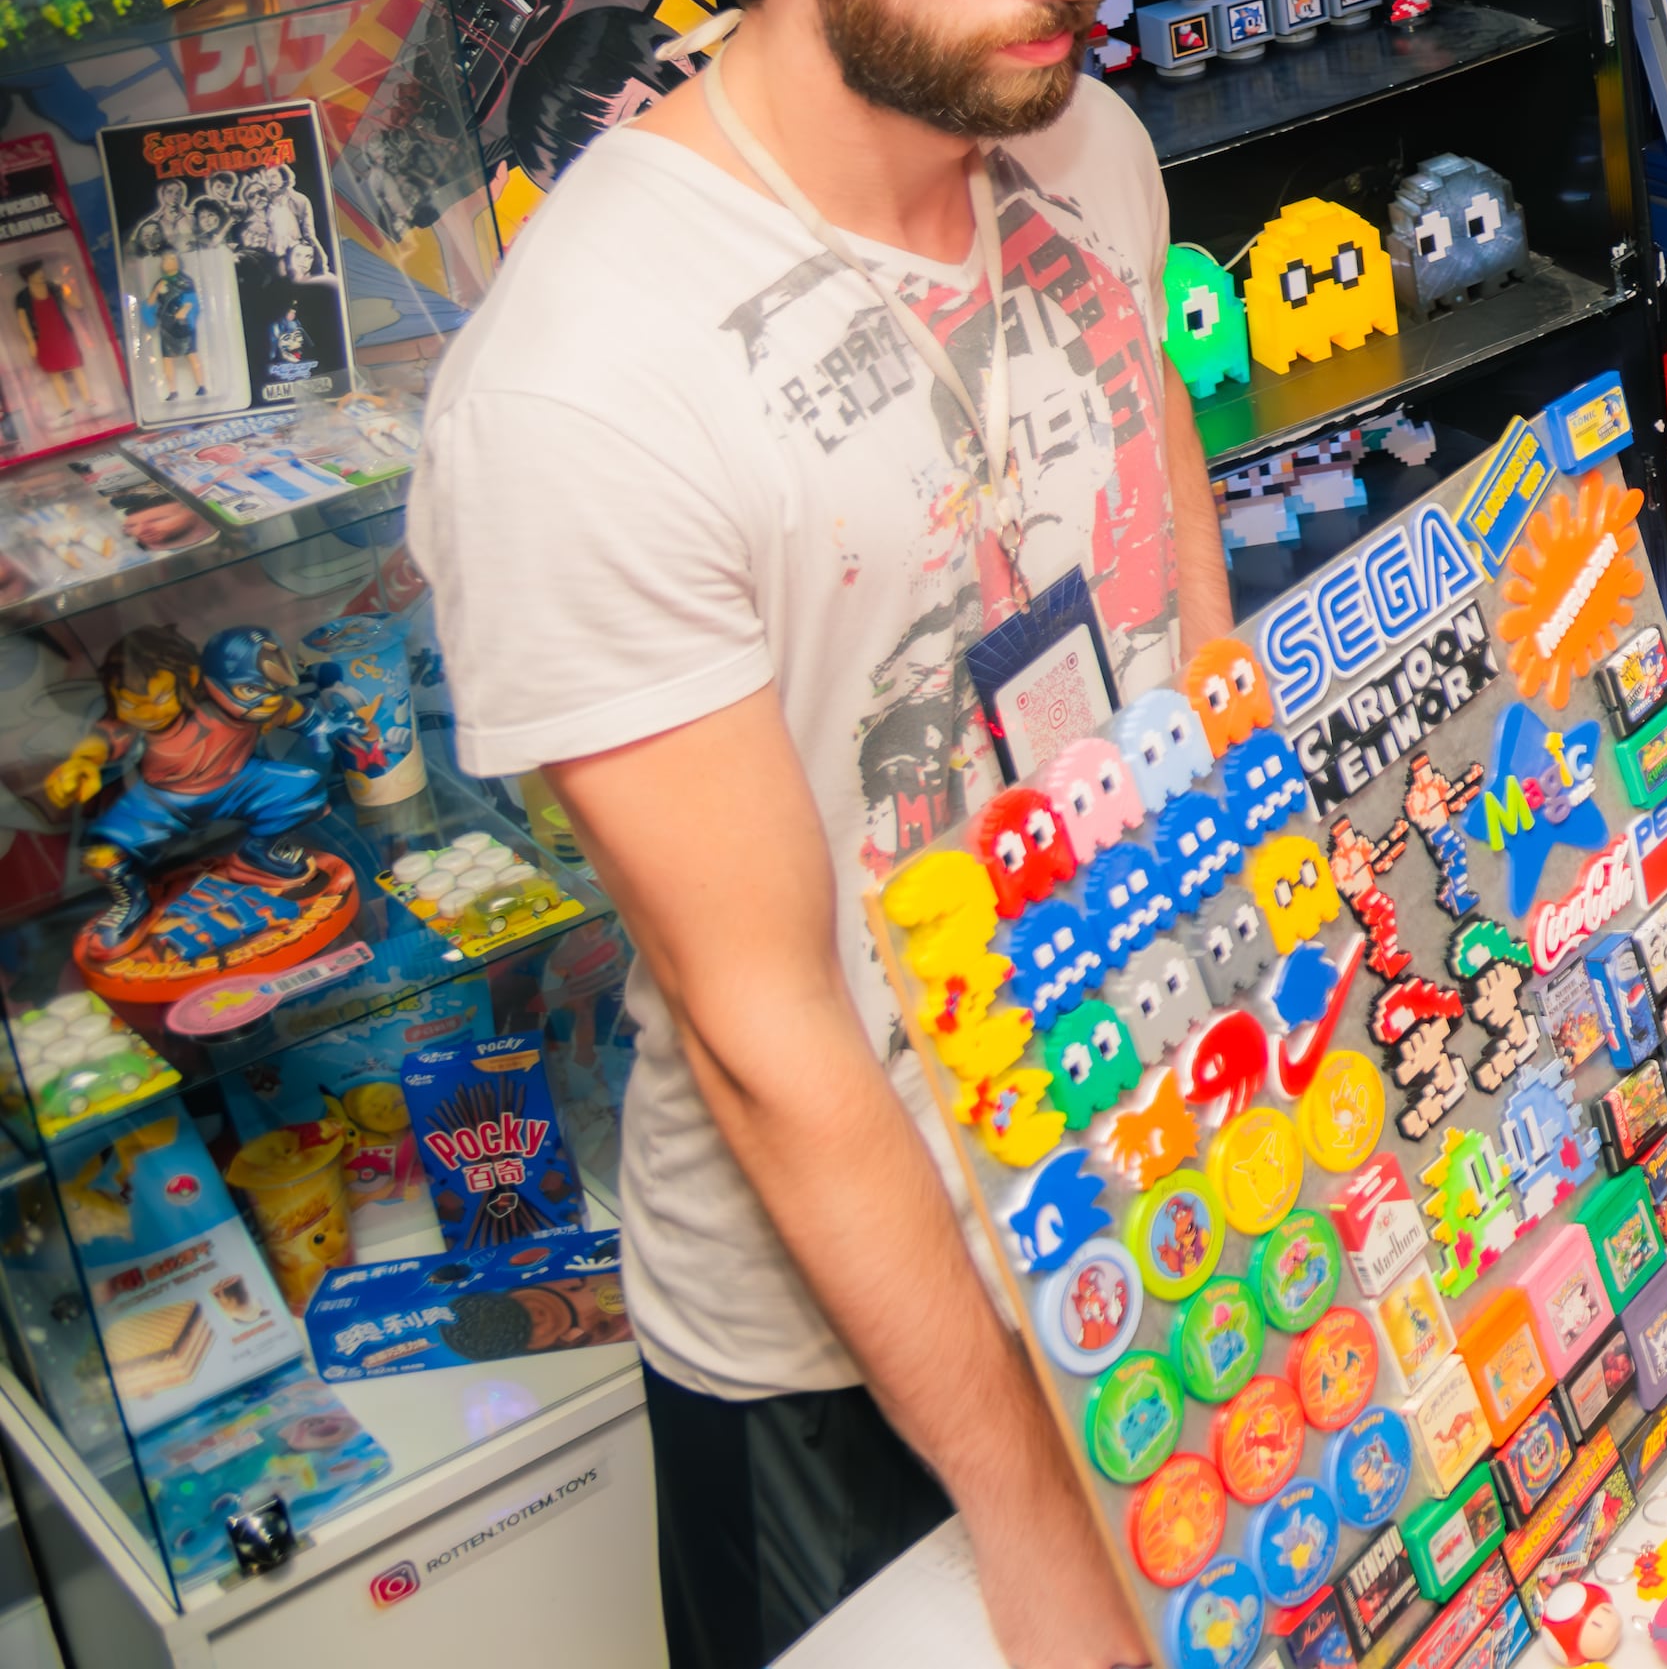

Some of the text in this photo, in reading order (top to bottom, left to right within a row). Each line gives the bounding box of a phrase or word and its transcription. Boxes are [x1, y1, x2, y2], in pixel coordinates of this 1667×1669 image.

[1262, 502, 1486, 728] SEGA
[1296, 603, 1487, 777] CARTOON
[1312, 651, 1500, 822] NETWORK
[424, 1112, 550, 1170] POCKY
[463, 1158, 526, 1194] 百奇
[1371, 1222, 1422, 1279] Marlboro
[426, 1466, 600, 1576] ROTTEN.TOTEM.TOYS
